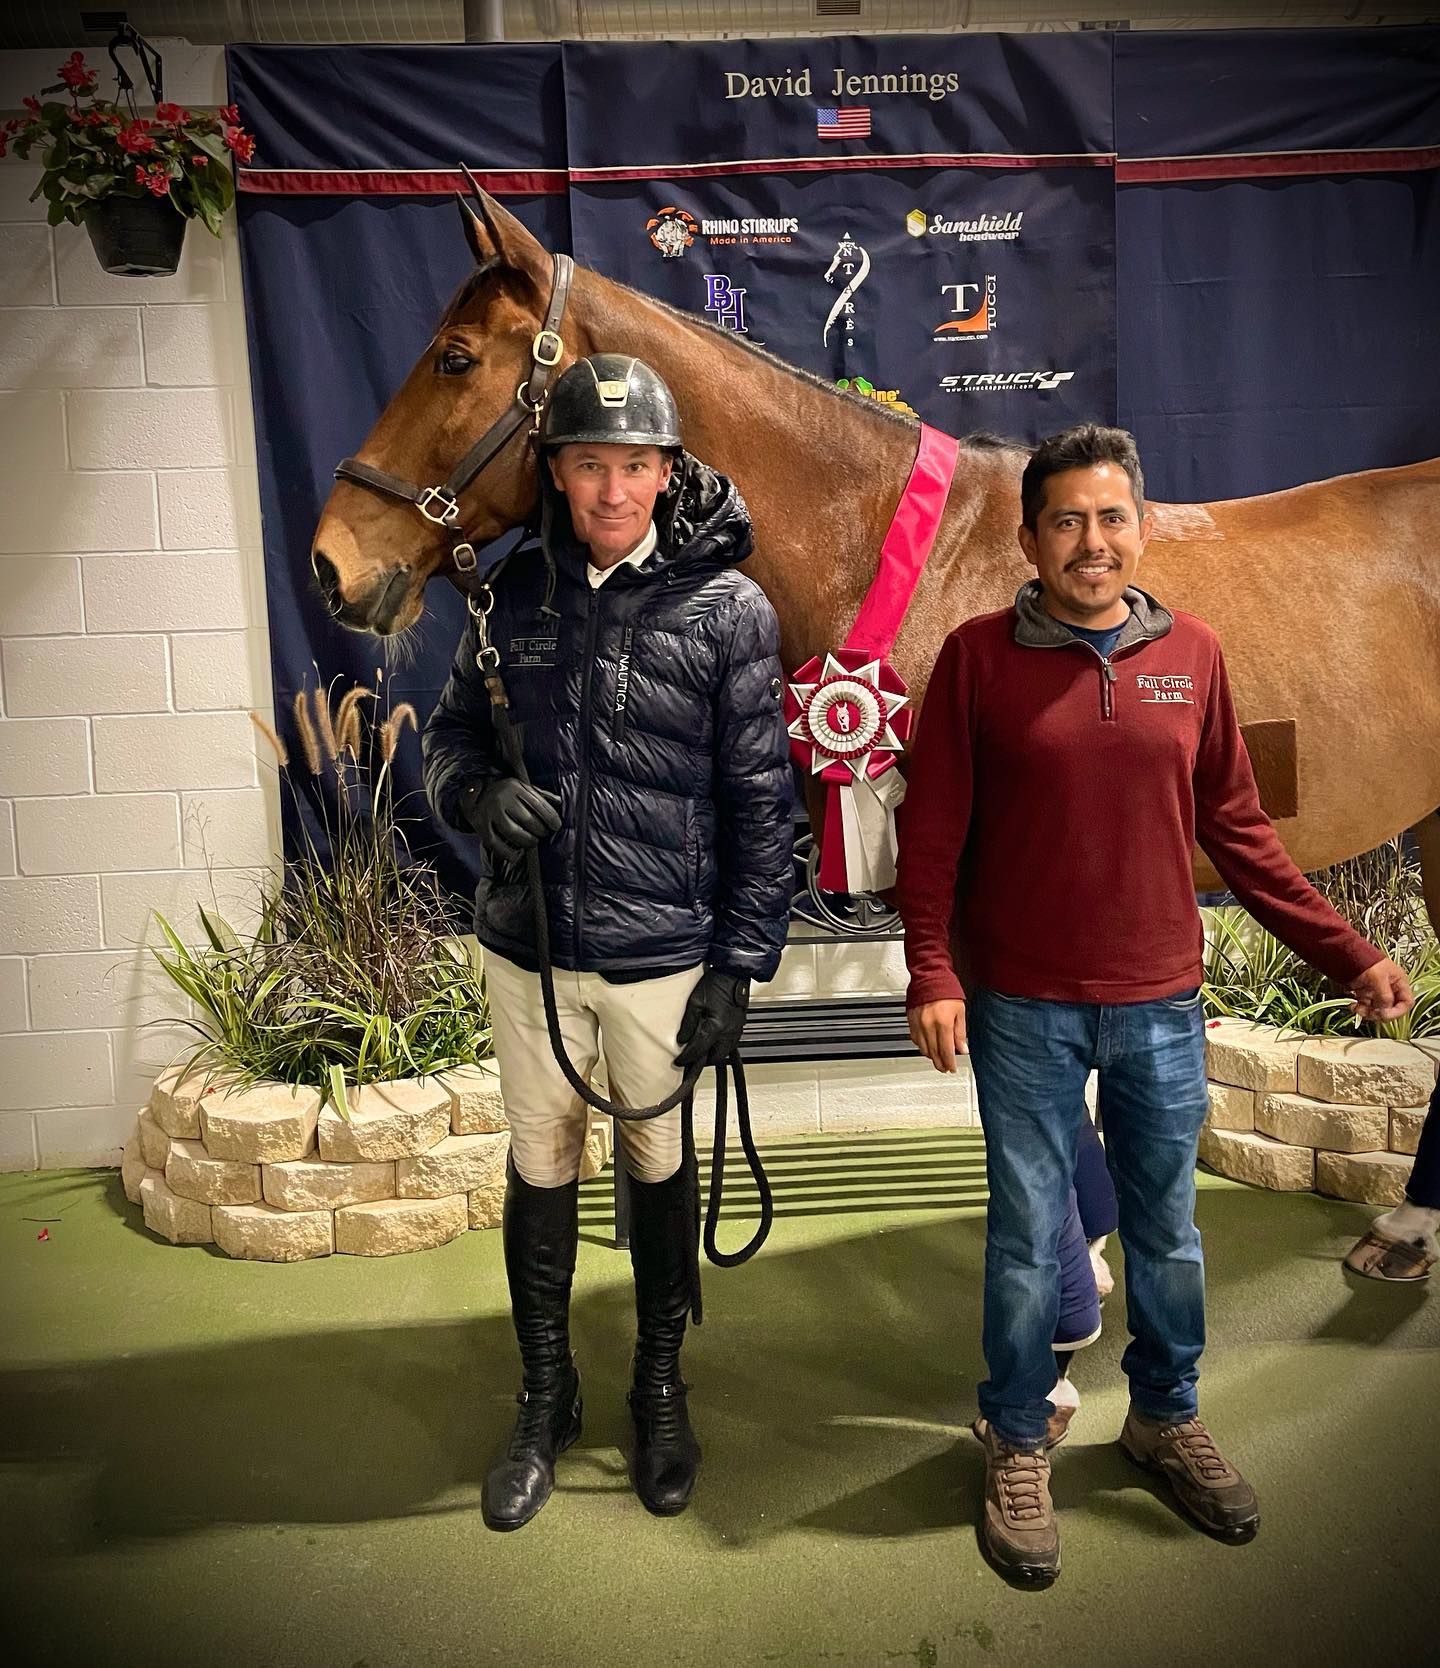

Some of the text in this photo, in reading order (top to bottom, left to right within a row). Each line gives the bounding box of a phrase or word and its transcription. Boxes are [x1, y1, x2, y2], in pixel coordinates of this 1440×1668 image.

[724, 65, 960, 101] David Jennings
[702, 218, 799, 235] RHINO STIRRUPS
[928, 211, 1024, 234] Samshield
[710, 236, 792, 245] Made in America
[959, 231, 1020, 242] headwear
[941, 283, 979, 313] T
[987, 274, 997, 331] TUCCI
[939, 371, 1053, 387] STRUCK
[529, 640, 557, 651] Circle
[615, 653, 630, 712] NAUTICA
[1137, 678, 1194, 690] Full Circle
[1154, 690, 1184, 700] Farm
